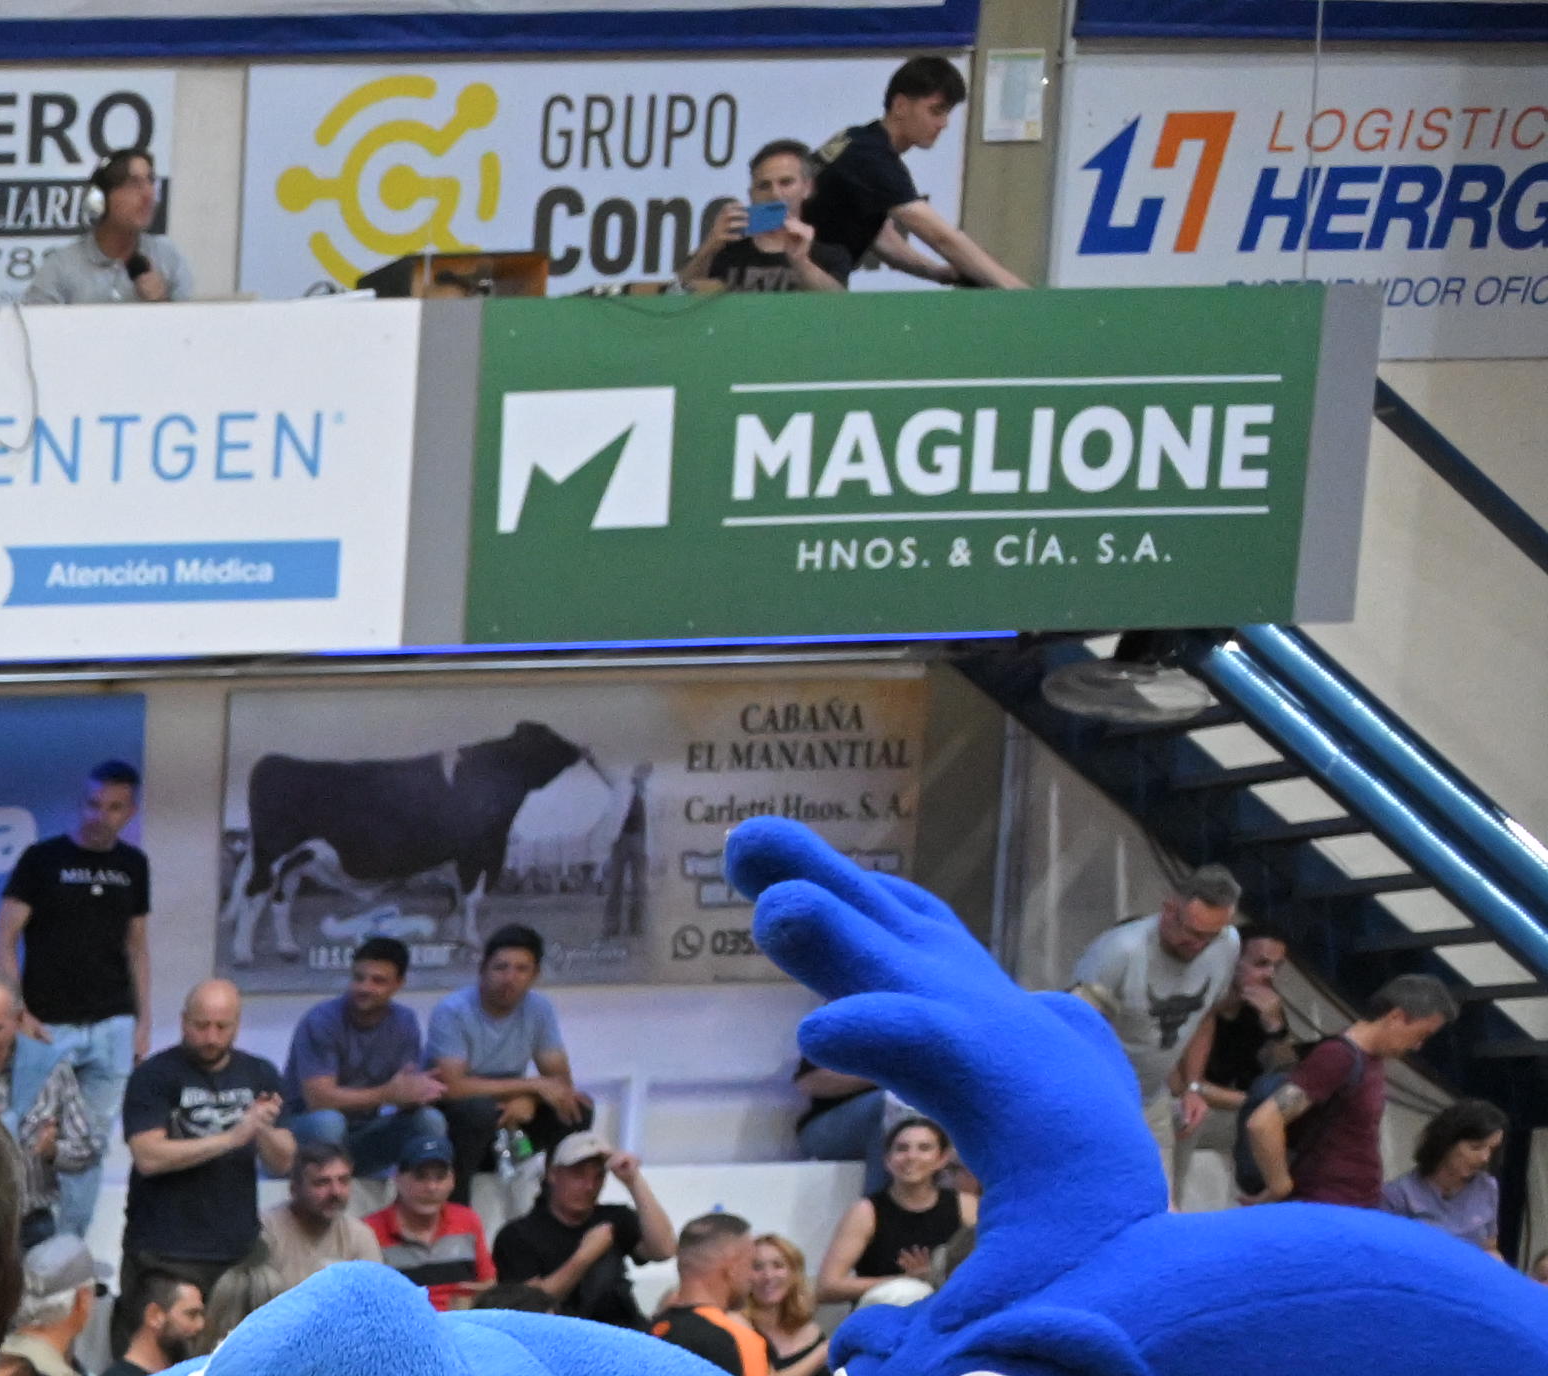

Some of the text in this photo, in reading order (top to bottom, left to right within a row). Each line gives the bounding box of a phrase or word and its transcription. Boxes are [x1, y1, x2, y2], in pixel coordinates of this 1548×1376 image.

[541, 92, 738, 171] GRUPO
[731, 402, 1275, 503] MAGLIONE
[46, 557, 168, 591] Atención
[174, 555, 274, 588] Médica
[797, 536, 930, 572] HNOS.
[993, 527, 1078, 567] CÍA.
[1097, 532, 1174, 566] S.A.
